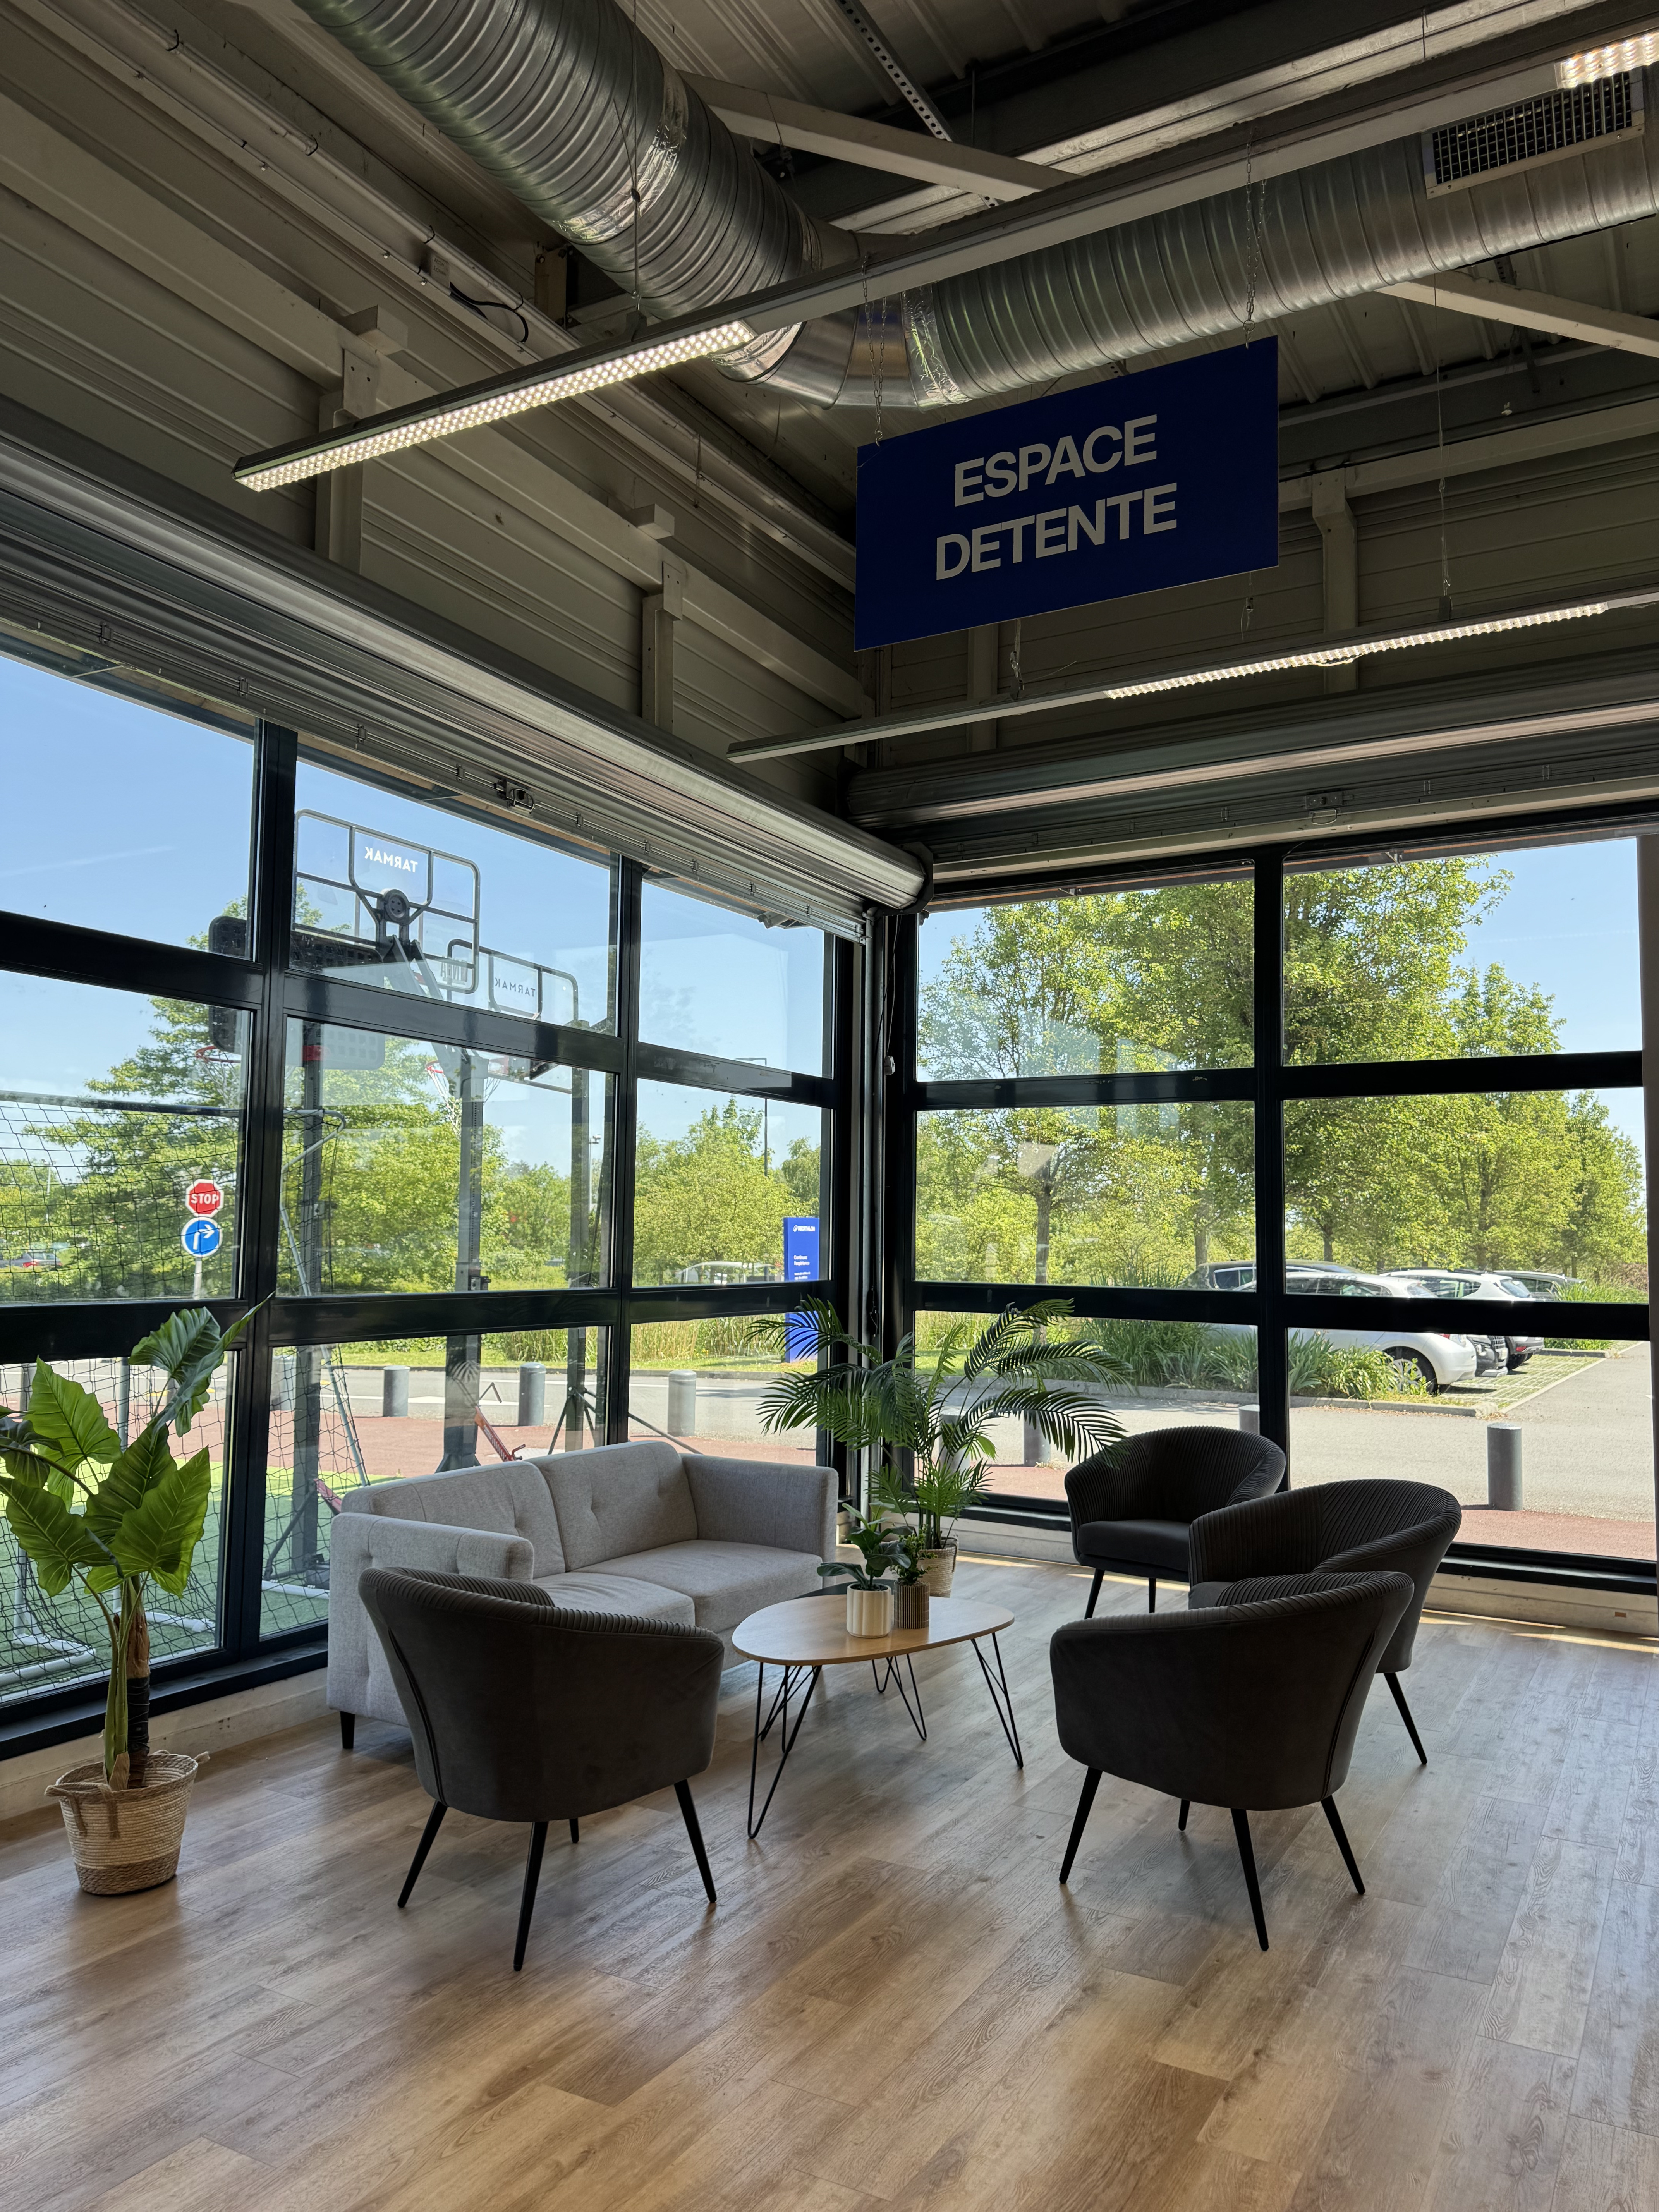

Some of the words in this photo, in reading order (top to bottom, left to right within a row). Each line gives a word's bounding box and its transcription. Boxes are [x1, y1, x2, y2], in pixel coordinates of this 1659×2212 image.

[954, 414, 1158, 507] ESPACE
[936, 482, 1177, 581] DETENTE
[191, 1193, 219, 1204] STOP
